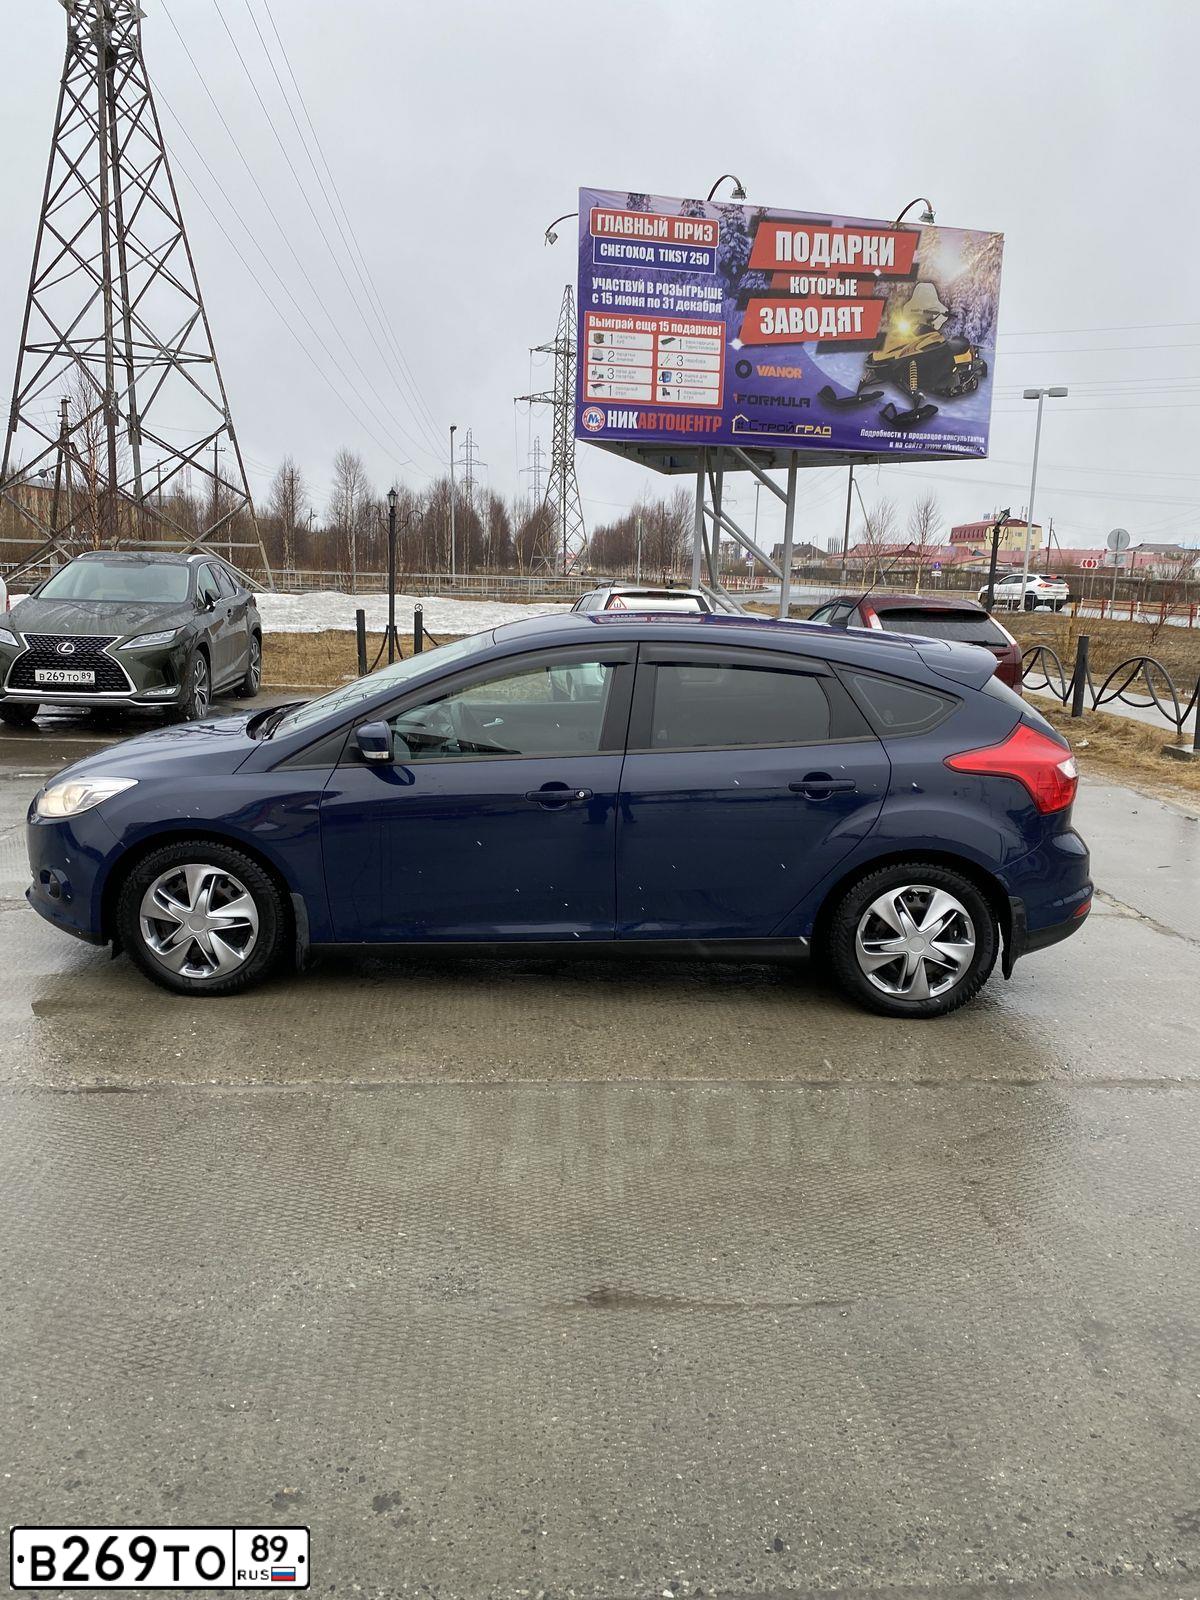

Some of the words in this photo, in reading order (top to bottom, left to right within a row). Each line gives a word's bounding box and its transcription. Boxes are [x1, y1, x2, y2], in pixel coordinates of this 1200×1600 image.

[597, 214, 668, 238] ГЛАВНЫЙ
[674, 221, 713, 241] ПРИЗ
[600, 243, 655, 262] СНЕГОХОД
[659, 248, 688, 264] TIKSY
[689, 251, 709, 266] 250
[775, 231, 895, 268] ПОДАРКИ
[592, 277, 645, 294] УЧАСТВУЙ
[647, 282, 654, 294] В
[656, 282, 723, 300] РОЗЫГРЫШЕ
[790, 276, 858, 296] КОТОРЫЕ
[601, 292, 612, 305] 15
[614, 295, 646, 307] июня
[647, 297, 661, 309] по
[662, 298, 674, 310] 31
[676, 298, 722, 314] декабря
[589, 315, 634, 330] Выиграй
[636, 321, 657, 333] еще
[658, 321, 669, 332] 15
[671, 324, 722, 336] подарков!
[759, 306, 865, 337] ЗАВОДЯТ
[607, 350, 615, 363] 2
[676, 355, 684, 367] 3
[607, 367, 615, 380] 3
[676, 372, 684, 384] 3
[607, 410, 722, 433] НИКАВТОЦЕНТР
[860, 429, 901, 439] Подробности
[905, 441, 922, 449] сайте
[39, 671, 79, 681] В269ТО
[81, 672, 91, 680] 89
